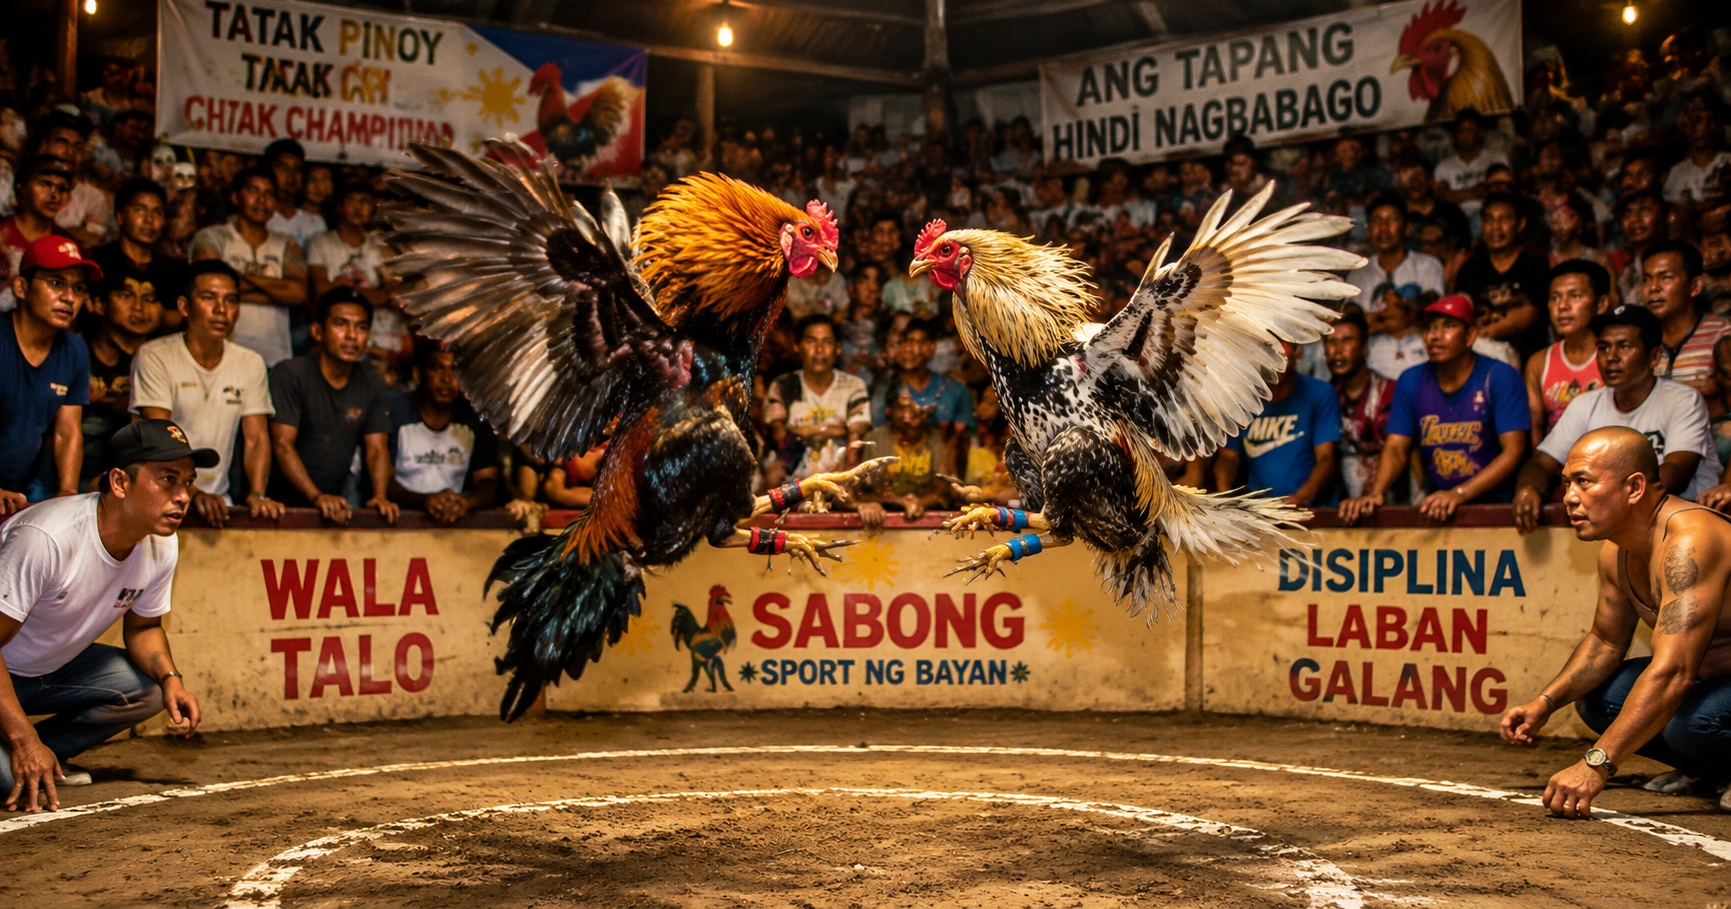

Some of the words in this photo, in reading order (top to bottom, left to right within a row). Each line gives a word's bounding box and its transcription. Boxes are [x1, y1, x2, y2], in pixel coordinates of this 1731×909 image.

[206, 1, 325, 53] TATAK
[1076, 56, 1160, 108] ANG
[1175, 21, 1354, 90] TAPANG
[1155, 75, 1382, 148] NAGBABAGO
[260, 557, 439, 620] WALA
[1278, 549, 1526, 597] DISIPLINA
[751, 592, 1025, 650] SABONG
[1307, 604, 1488, 655] LABAN
[271, 632, 435, 700] TALO
[760, 659, 855, 686] SPORT
[865, 659, 904, 686] NG
[915, 659, 1007, 686] BAYAN
[1289, 658, 1508, 715] GALANG
